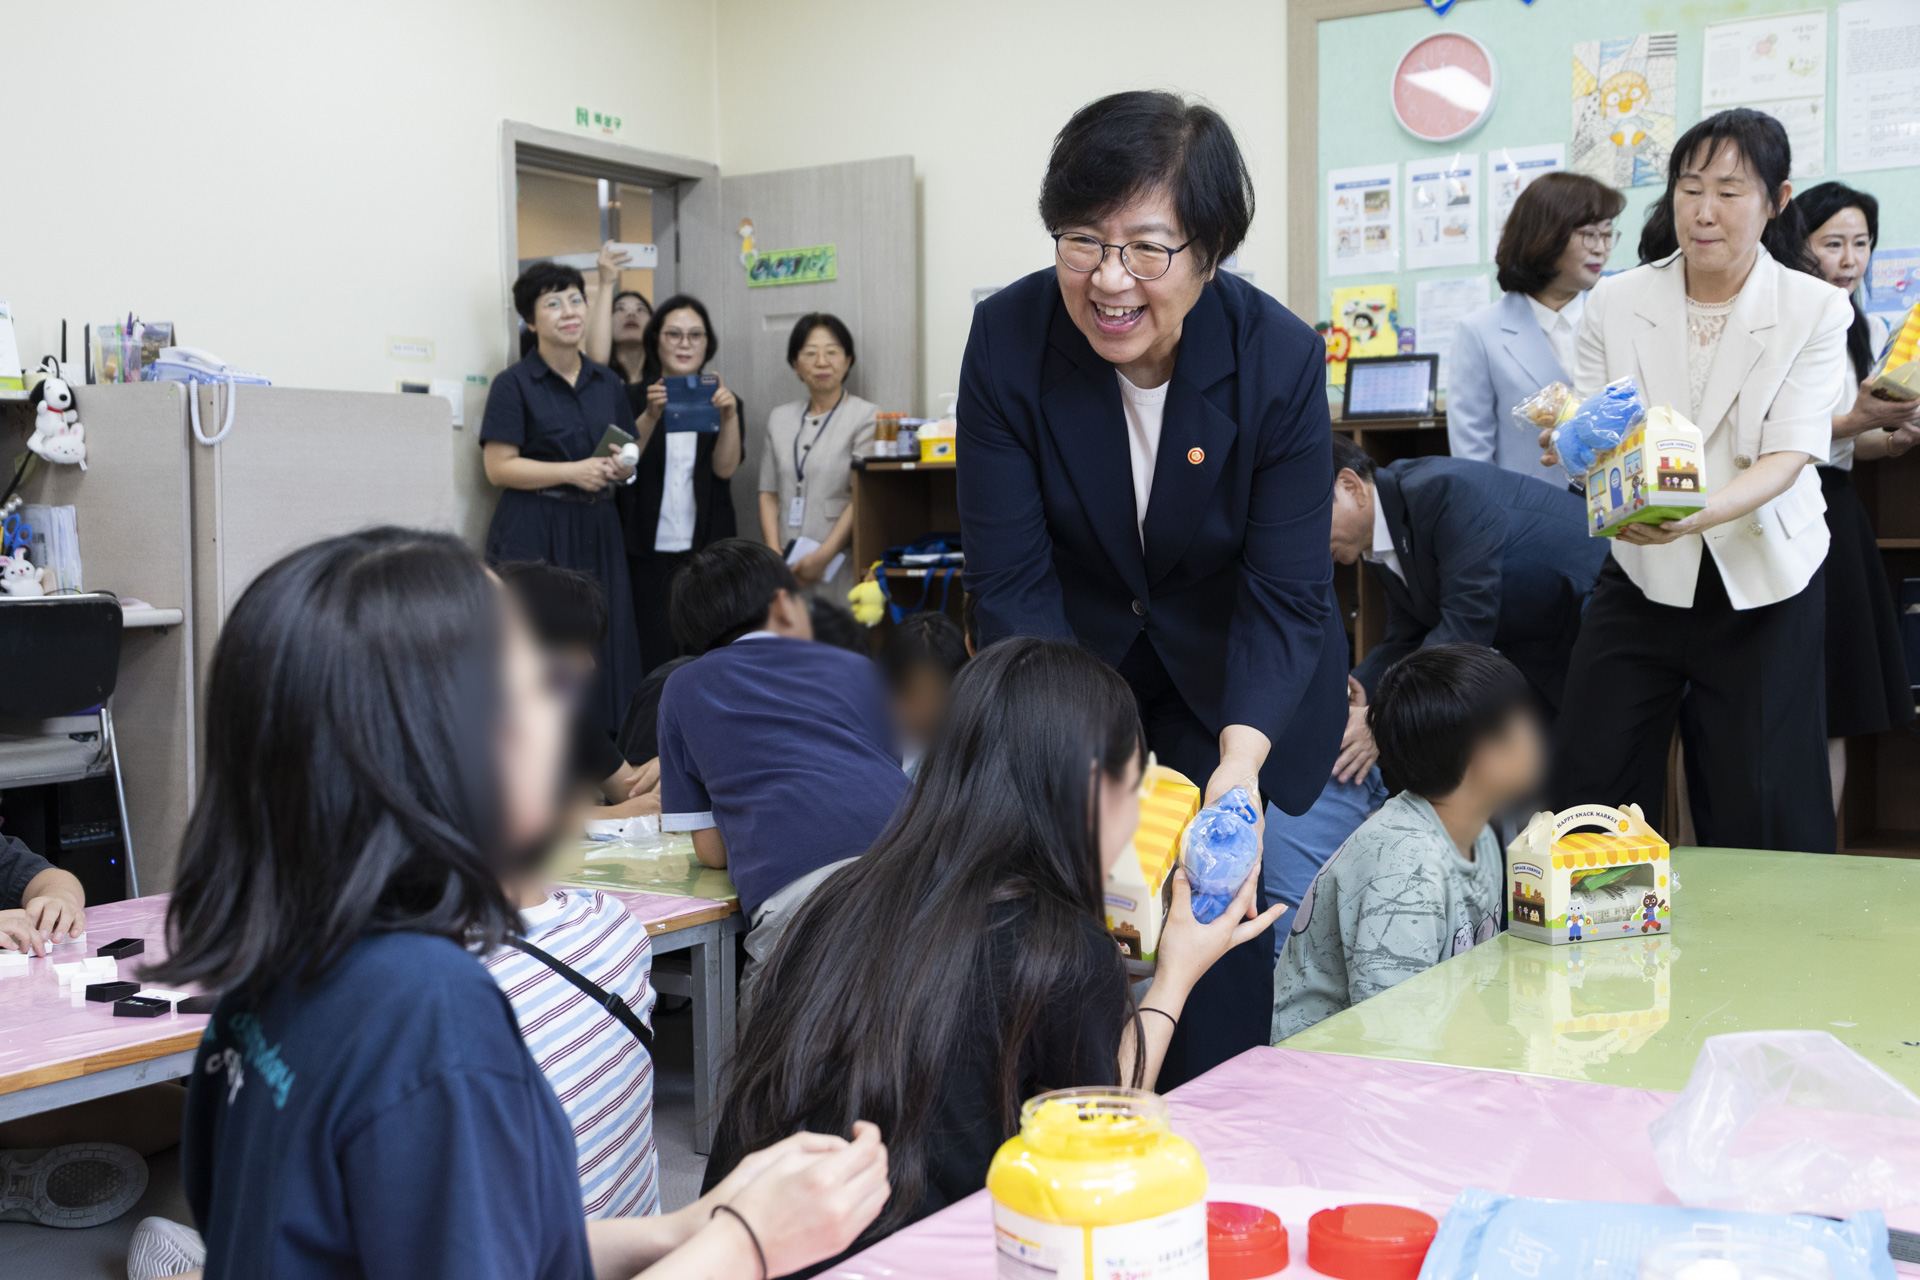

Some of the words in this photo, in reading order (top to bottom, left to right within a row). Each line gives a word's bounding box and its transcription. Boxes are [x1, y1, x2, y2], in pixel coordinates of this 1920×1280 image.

[1556, 815, 1574, 829] HAPPY
[1575, 811, 1595, 819] SNACK
[1595, 812, 1618, 824] MARKET
